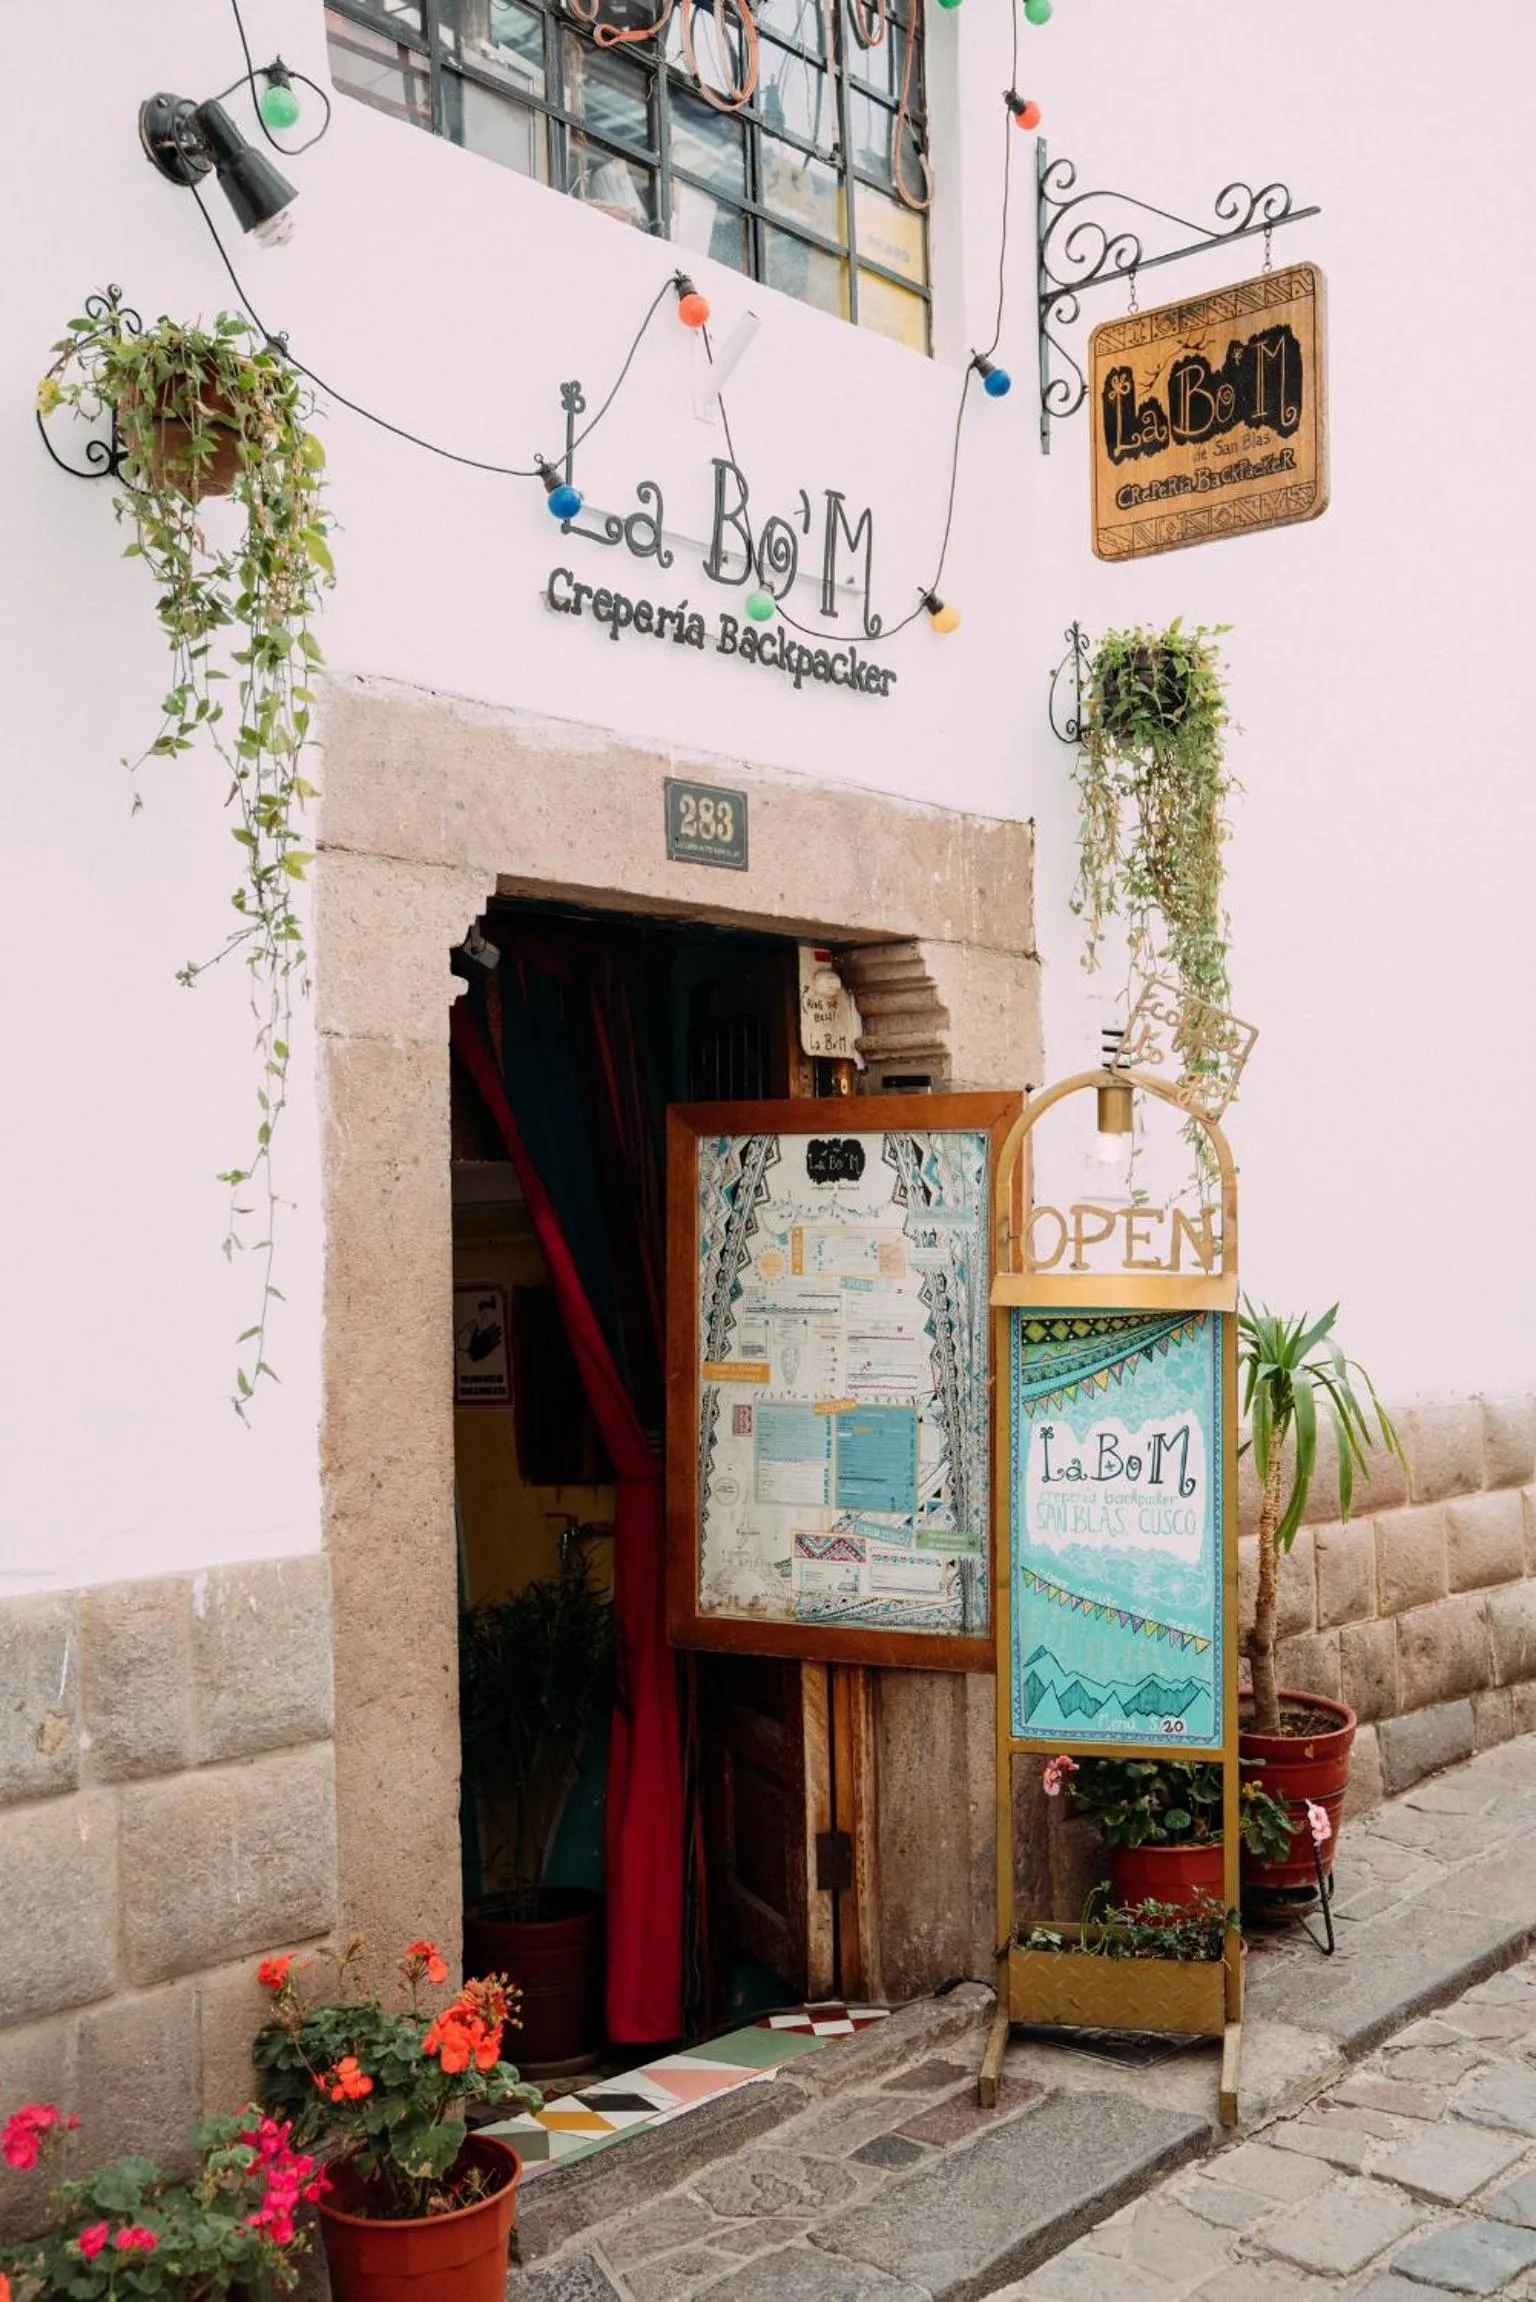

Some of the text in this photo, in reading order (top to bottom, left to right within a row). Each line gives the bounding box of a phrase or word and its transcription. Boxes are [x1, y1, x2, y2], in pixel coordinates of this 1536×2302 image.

[1107, 373, 1167, 453] La
[1213, 440, 1239, 457] San
[1242, 432, 1272, 450] Blas
[559, 379, 674, 569] La
[548, 567, 897, 697] Crepería Backpacker
[680, 794, 734, 843] 283
[810, 1033, 820, 1051] La
[1020, 1204, 1216, 1273] OPEN
[1040, 1426, 1088, 1483] La
[1037, 1503, 1197, 1538] SAN BLAS CUSCO
[1163, 1719, 1184, 1733] 20
